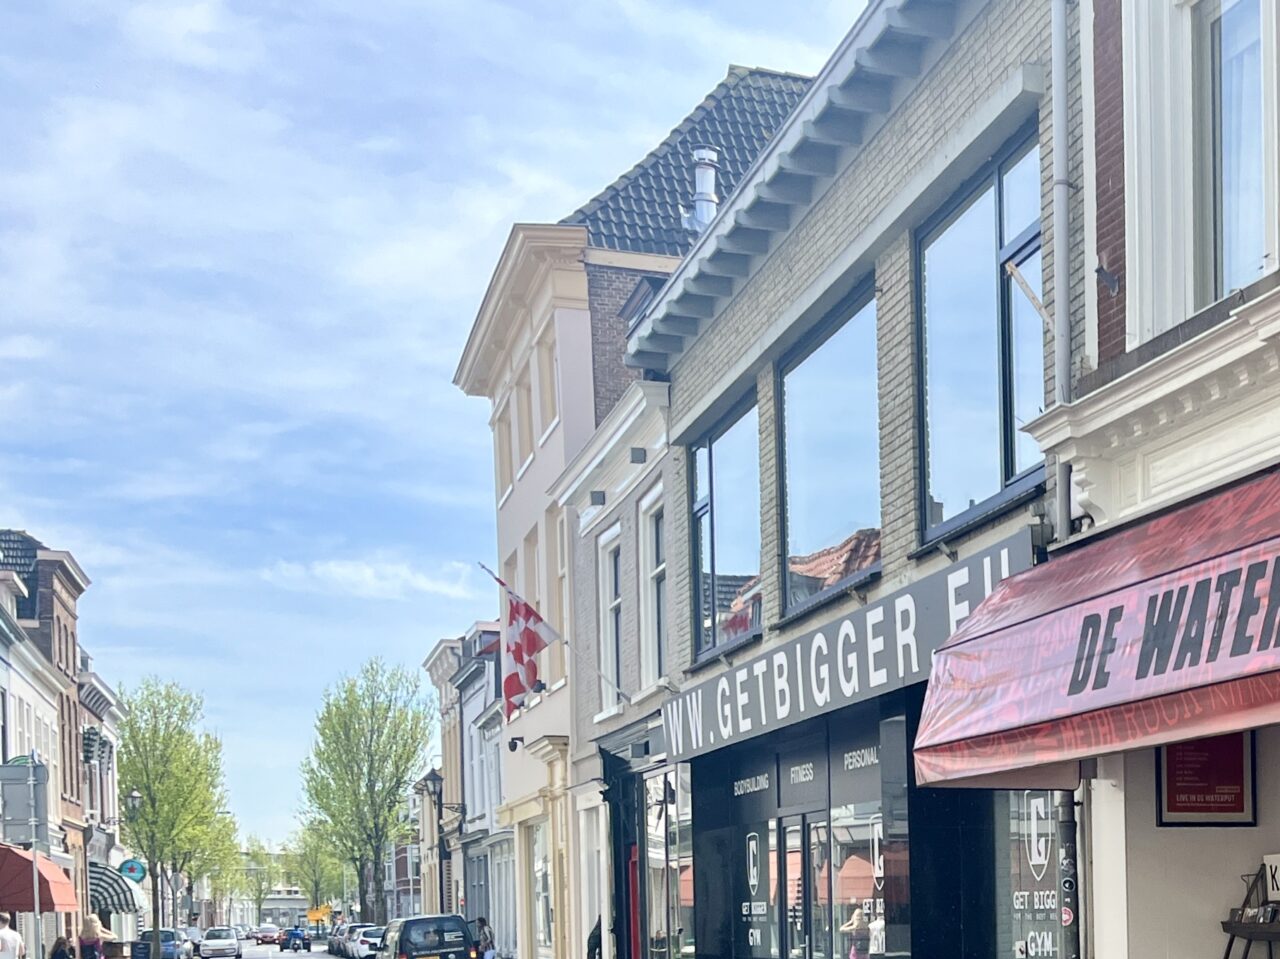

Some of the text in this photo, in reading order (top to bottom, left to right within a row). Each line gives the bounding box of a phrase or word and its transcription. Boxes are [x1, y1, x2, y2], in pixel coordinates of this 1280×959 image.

[1068, 605, 1124, 697] DE
[844, 746, 879, 771] PERSONAL
[734, 773, 769, 797] BODYBUILDING
[790, 763, 814, 785] FITNESS
[1013, 890, 1058, 910] GET BIGG
[1028, 930, 1053, 957] GYM
